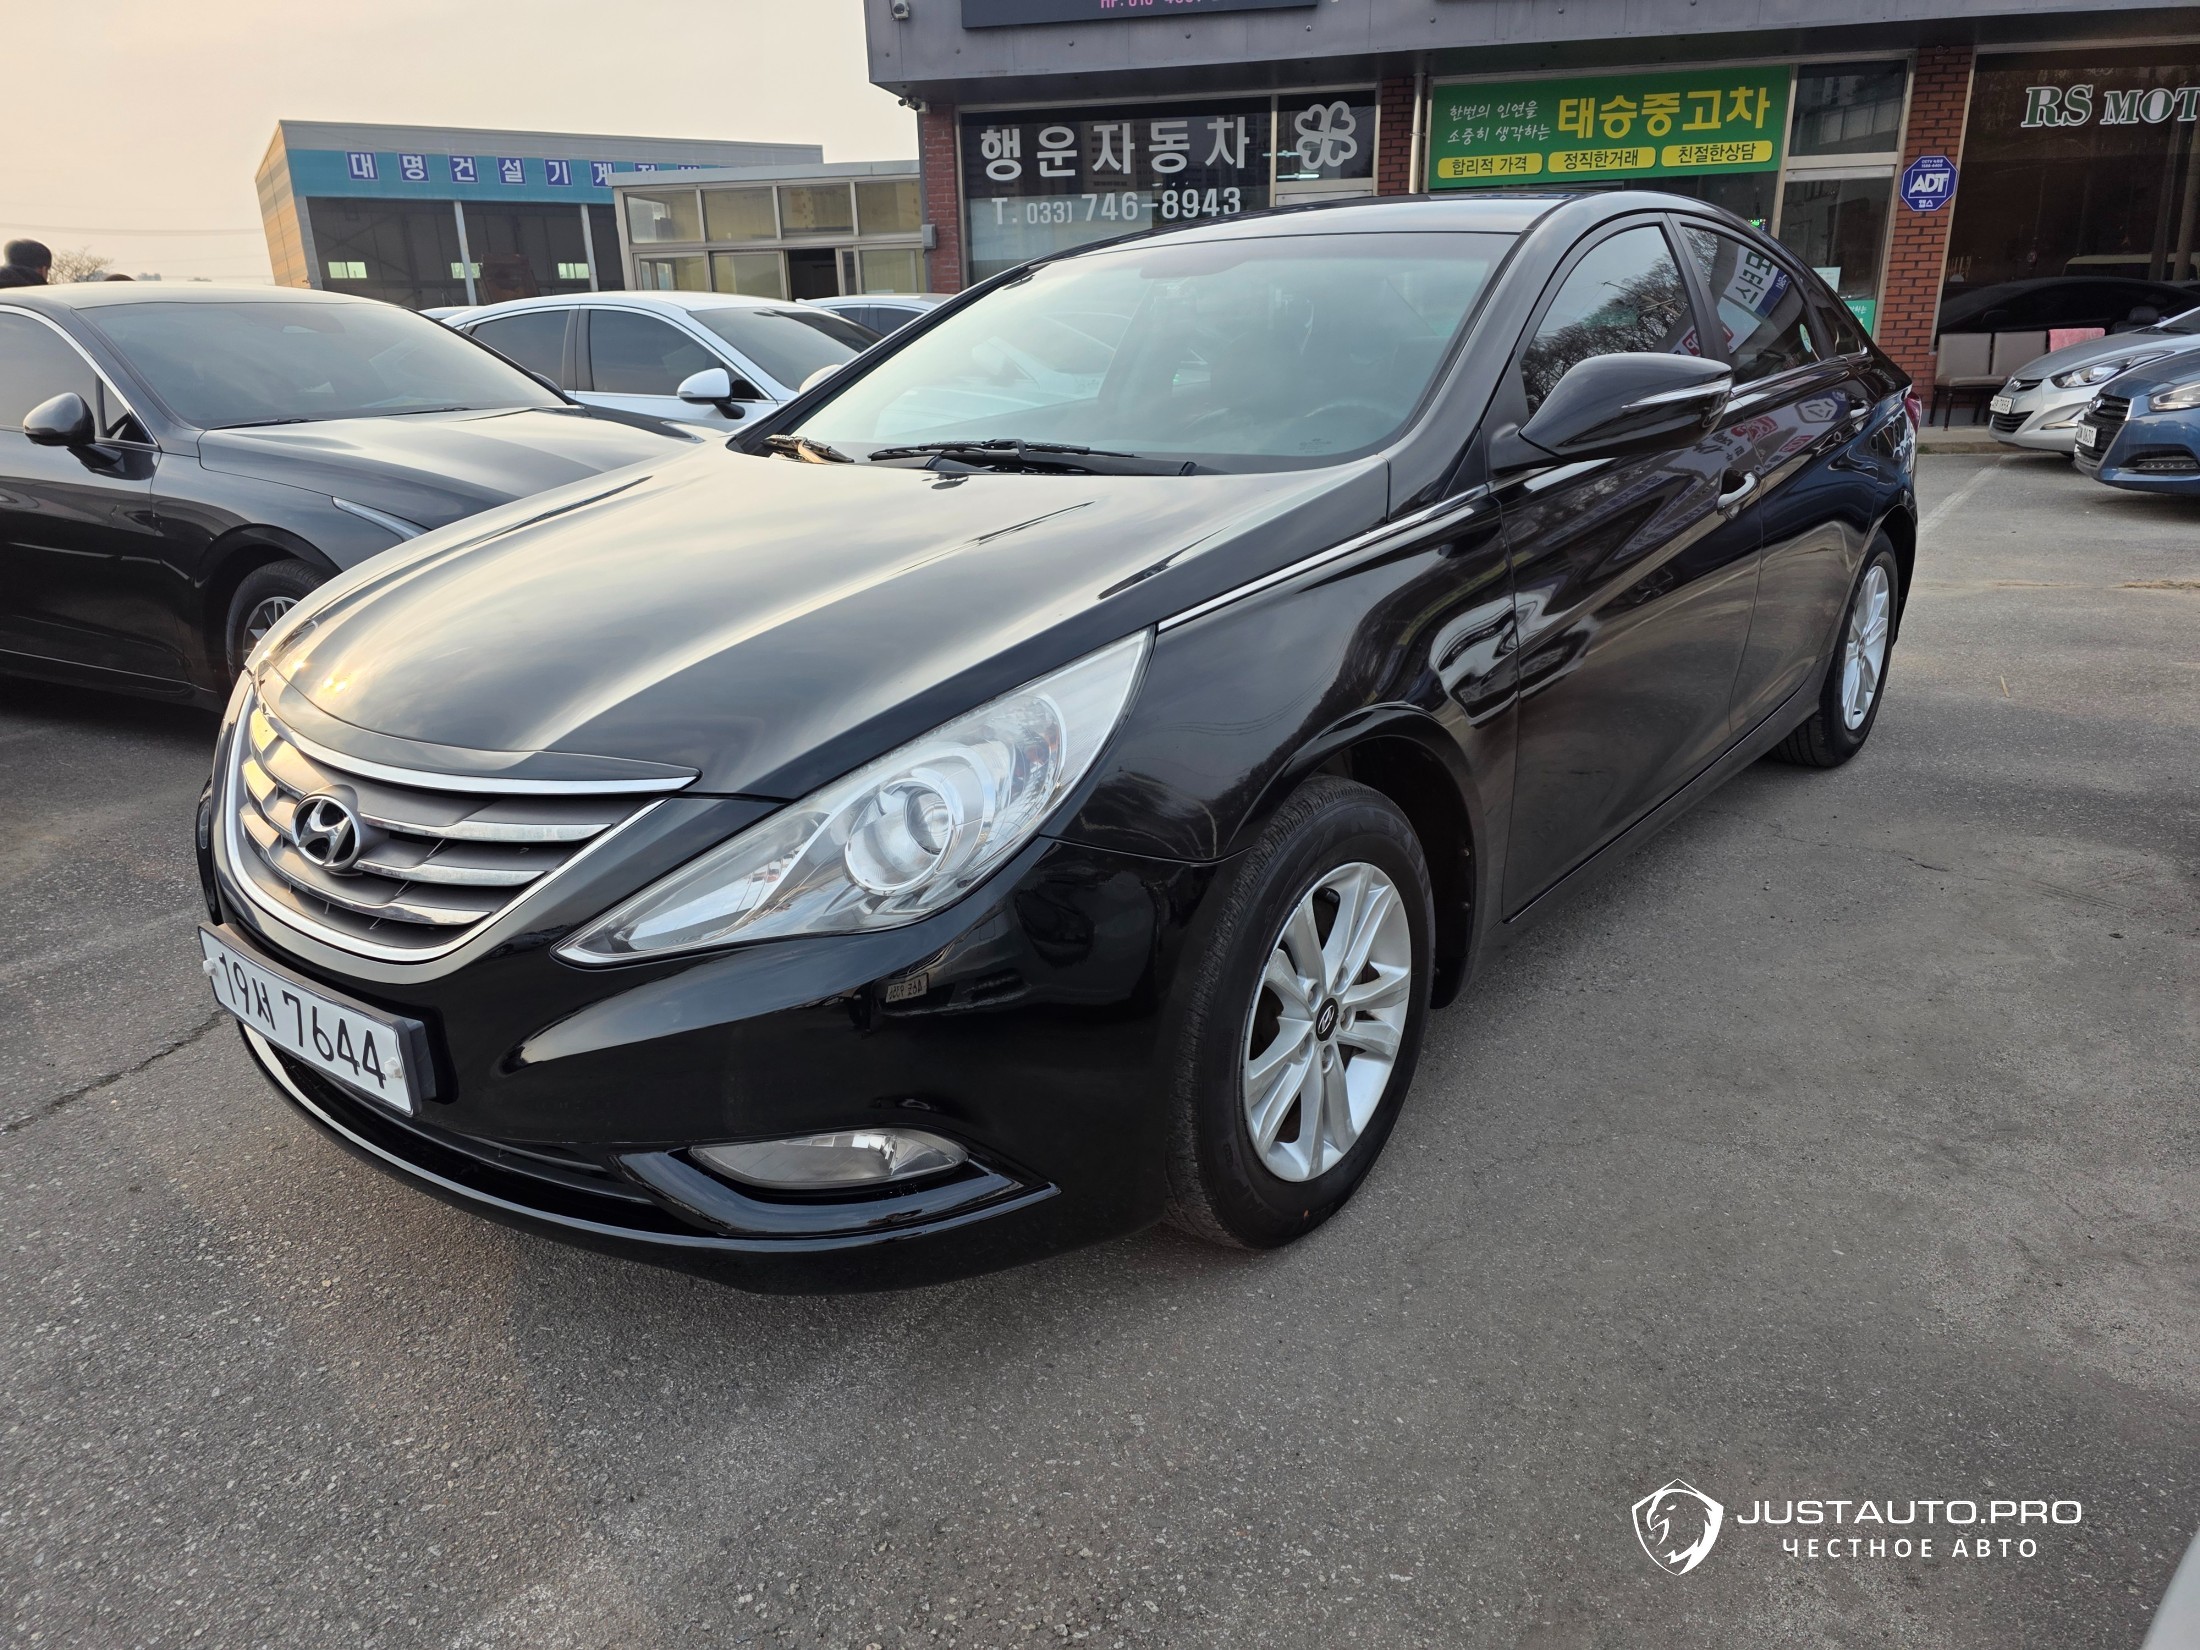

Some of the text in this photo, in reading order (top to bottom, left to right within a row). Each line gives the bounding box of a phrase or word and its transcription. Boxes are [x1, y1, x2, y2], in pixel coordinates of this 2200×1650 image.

[1450, 100, 1538, 121] 한번의 인연을
[1558, 87, 1771, 139] 태승중고차
[2021, 84, 2093, 127] RS
[1447, 123, 1551, 145] 소중히 생각하는
[981, 116, 1250, 181] 행운자동차
[1563, 150, 1639, 169] 정직한거래
[1678, 142, 1756, 162] 친절한상담
[350, 152, 698, 185] 대명건설기계
[1452, 156, 1527, 175] 합리적 가격
[1910, 173, 1949, 193] ADT
[992, 187, 1242, 225] T. 033) 746-8943
[218, 951, 387, 1090] 19서 7644
